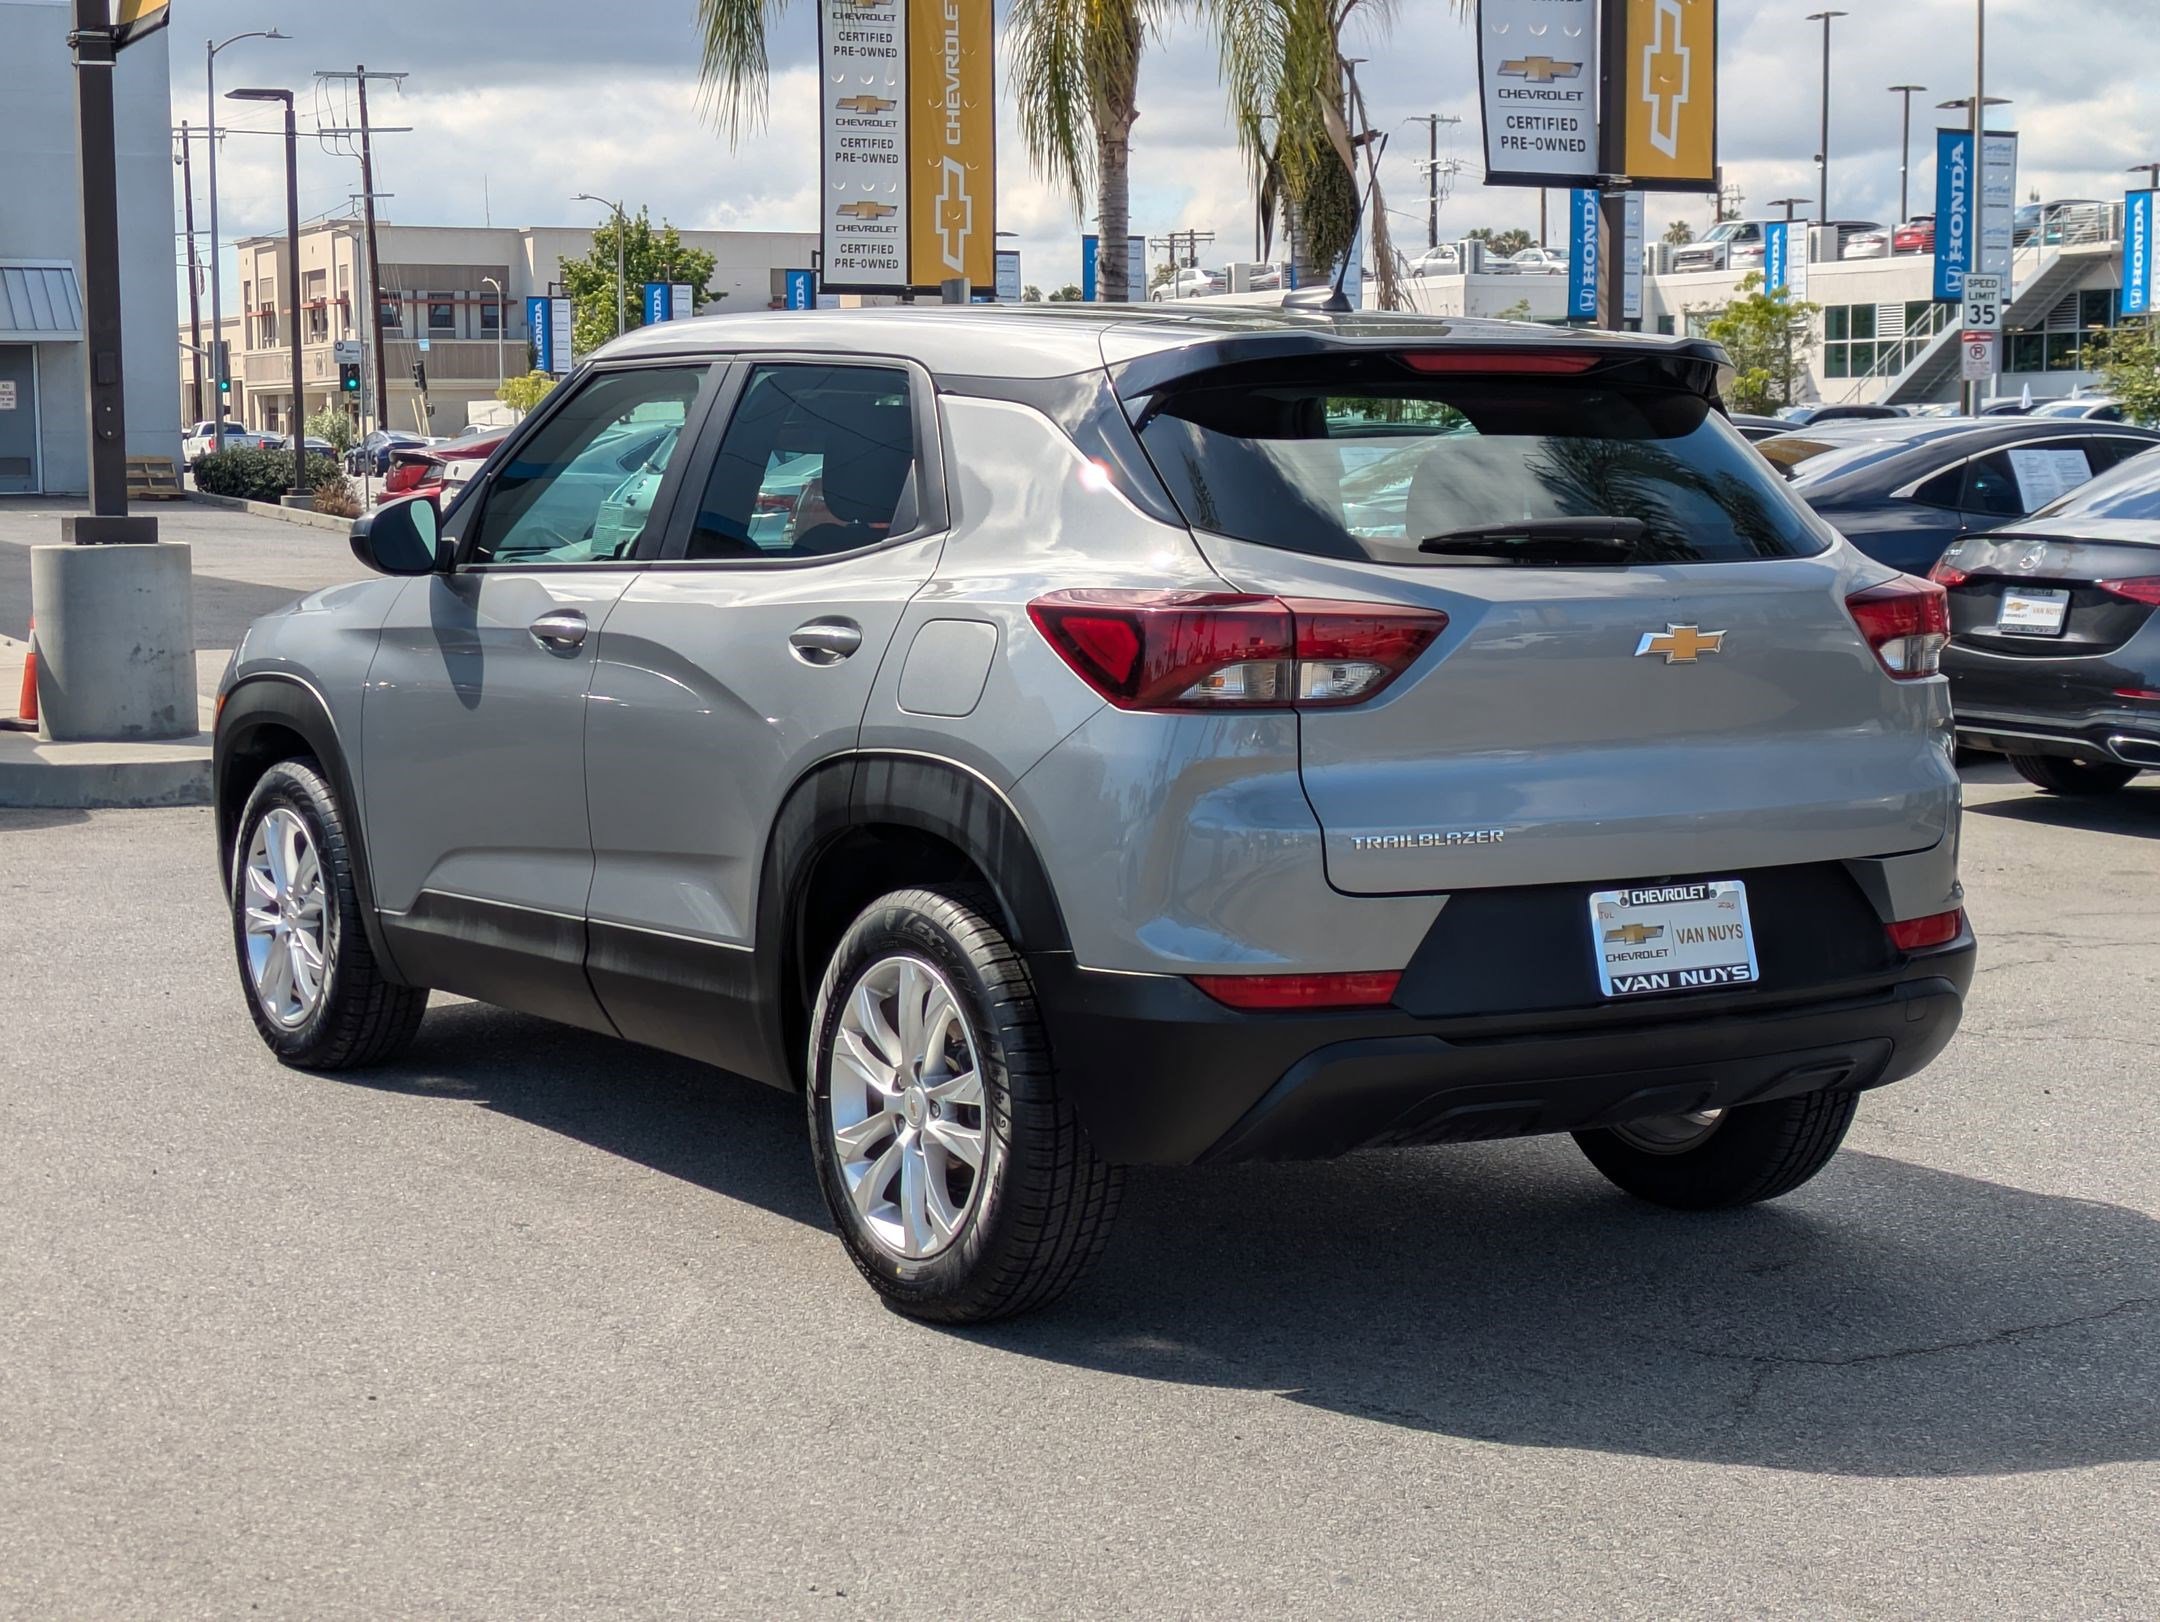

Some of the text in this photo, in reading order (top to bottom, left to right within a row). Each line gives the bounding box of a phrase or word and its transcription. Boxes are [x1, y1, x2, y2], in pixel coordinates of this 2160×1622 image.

[833, 12, 896, 22] CHEVROLET
[838, 31, 893, 43] CERTIFIED
[833, 46, 897, 58] PRE-OWNED
[944, 0, 961, 145] CHEVROLE
[1498, 88, 1584, 101] CHEVROLET
[835, 118, 898, 128] CHEVROLET
[1506, 115, 1578, 132] CERTIFIED
[840, 137, 894, 149] CERTIFIED
[1500, 136, 1586, 153] PRE-OWNED
[835, 152, 899, 164] PRE-OWNED
[1949, 141, 1965, 262] HONDA
[835, 224, 899, 233] CHEVROLET
[840, 243, 894, 254] CERTIFIED
[2132, 198, 2144, 286] HONDA
[834, 258, 899, 269] PRE-OWNED
[1772, 228, 1780, 289] ONDA
[1968, 278, 1997, 288] SPEED
[1968, 292, 1996, 300] LIMIT
[653, 287, 662, 323] NDA
[1969, 304, 1996, 325] 35
[1350, 829, 1505, 850] TRAILBLAZER
[1631, 885, 1706, 905] CHEVROLET
[1676, 923, 1743, 944] VAN NUYS
[1605, 948, 1669, 962] CHEVROLET
[1612, 965, 1750, 992] VAN NUYS
